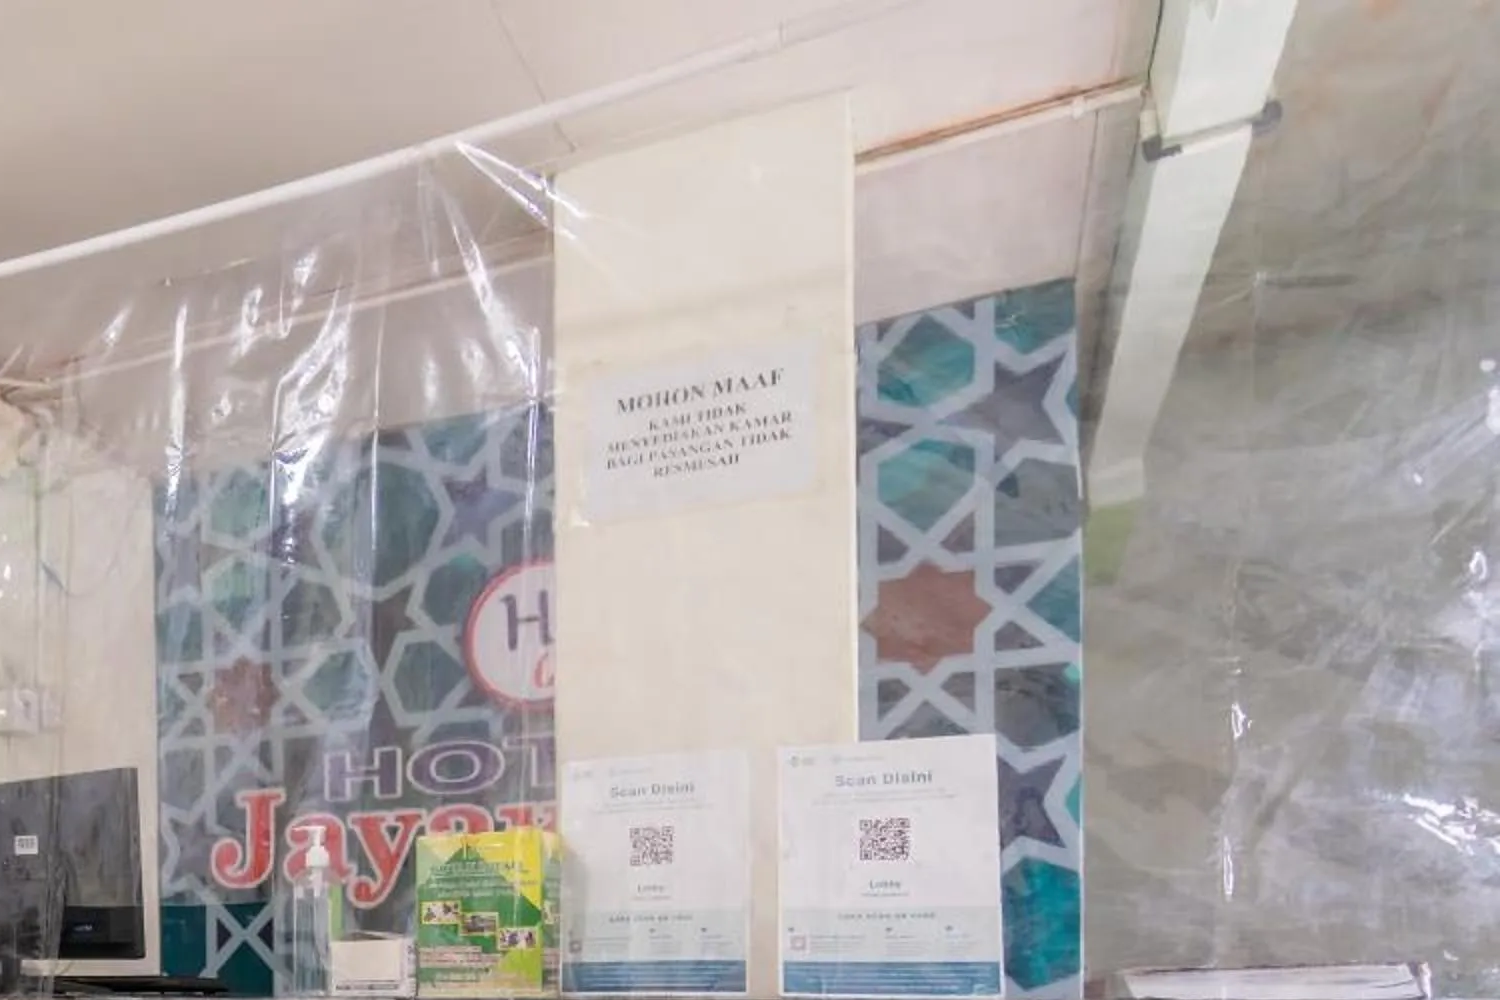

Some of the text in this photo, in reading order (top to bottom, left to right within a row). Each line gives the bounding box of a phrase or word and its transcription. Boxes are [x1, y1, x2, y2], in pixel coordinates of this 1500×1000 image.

[617, 367, 784, 414] MOHON MAAF
[649, 403, 746, 432] KAMI TIDAK
[730, 411, 792, 432] KAMAR
[607, 428, 790, 470] BAGI PASANGAN TIDAK
[611, 781, 694, 798] Scan Disini
[835, 770, 932, 787] Scan Disini
